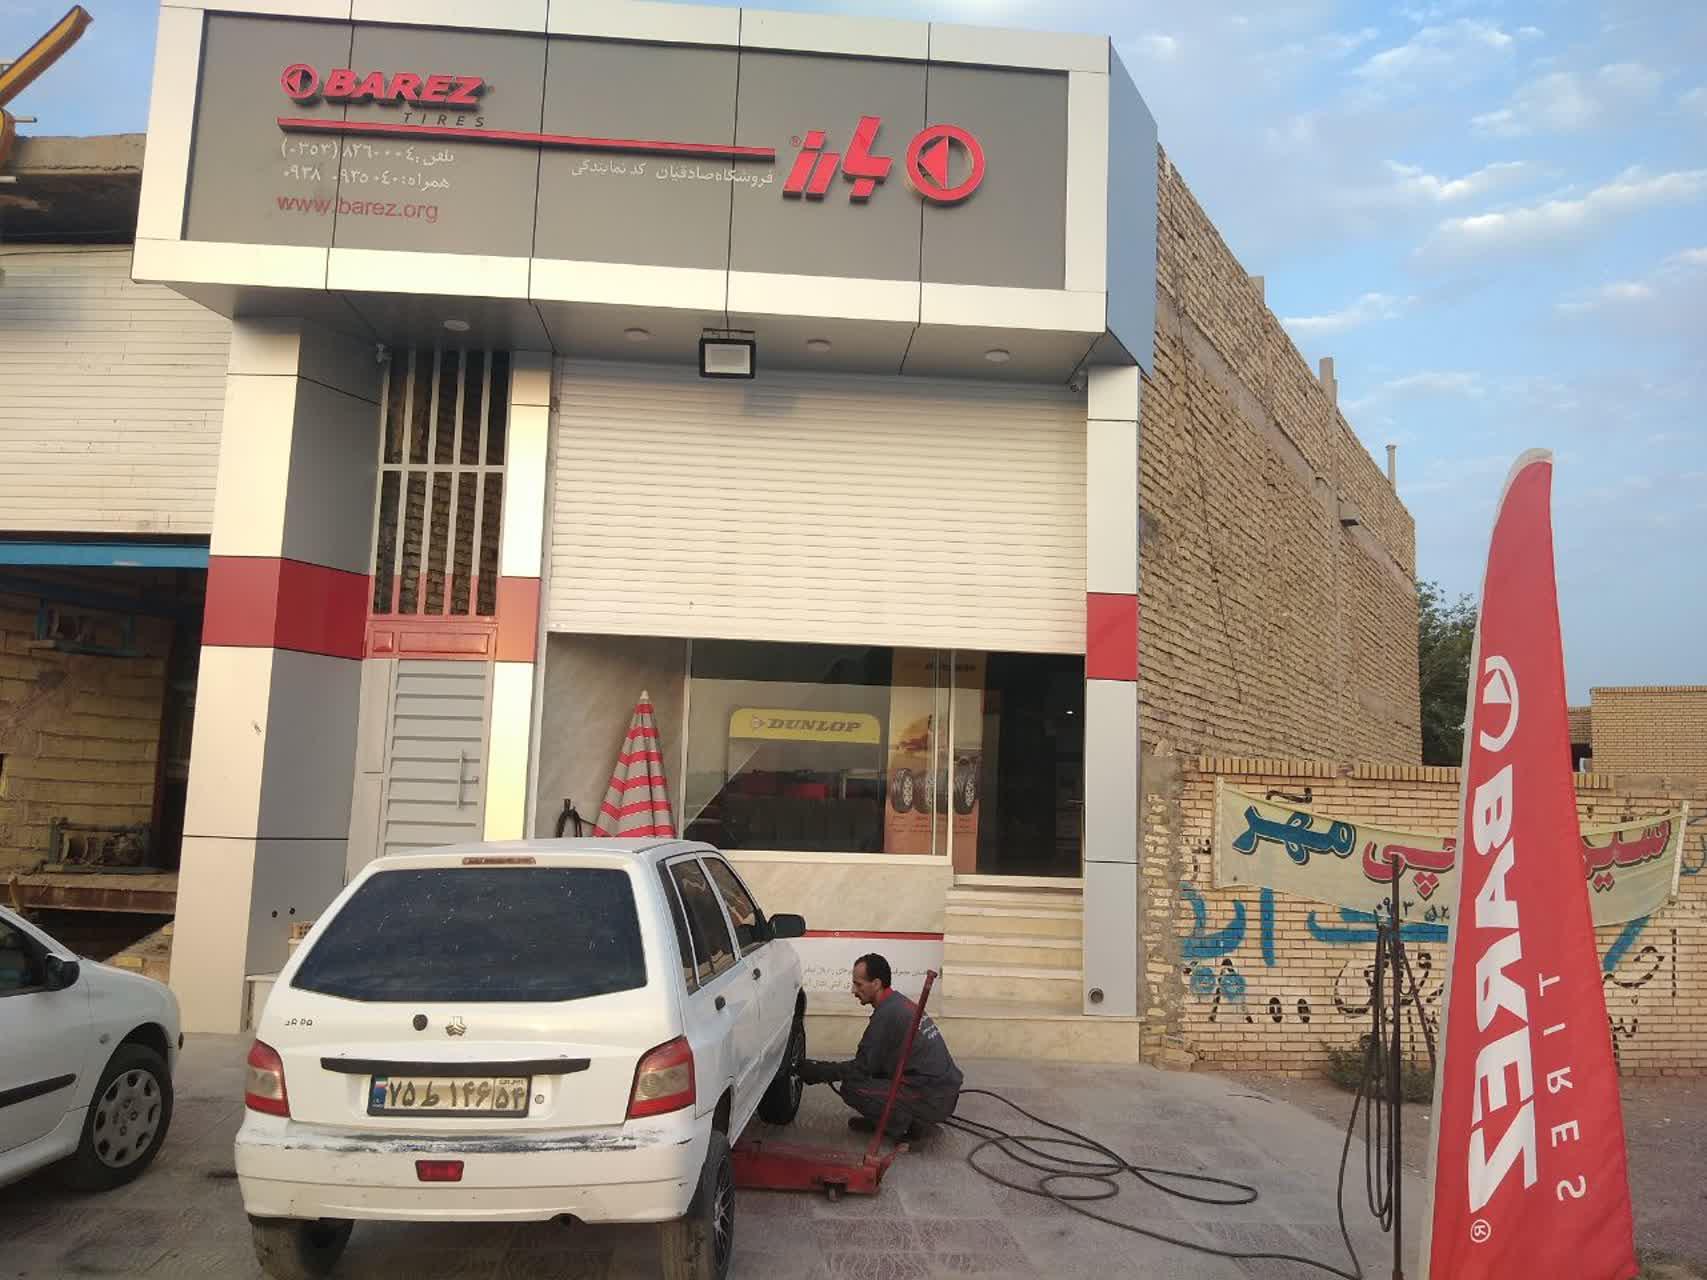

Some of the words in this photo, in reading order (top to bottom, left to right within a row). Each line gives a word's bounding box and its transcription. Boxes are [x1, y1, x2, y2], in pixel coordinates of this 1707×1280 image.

[323, 68, 486, 108] BAREZ
[402, 112, 486, 128] TIRES
[277, 194, 439, 224] www.barez.org
[767, 716, 863, 733] DUNLOP
[1232, 802, 1357, 866] مهر
[420, 1080, 441, 1107] ط
[449, 1080, 492, 1108] ۱۴۶
